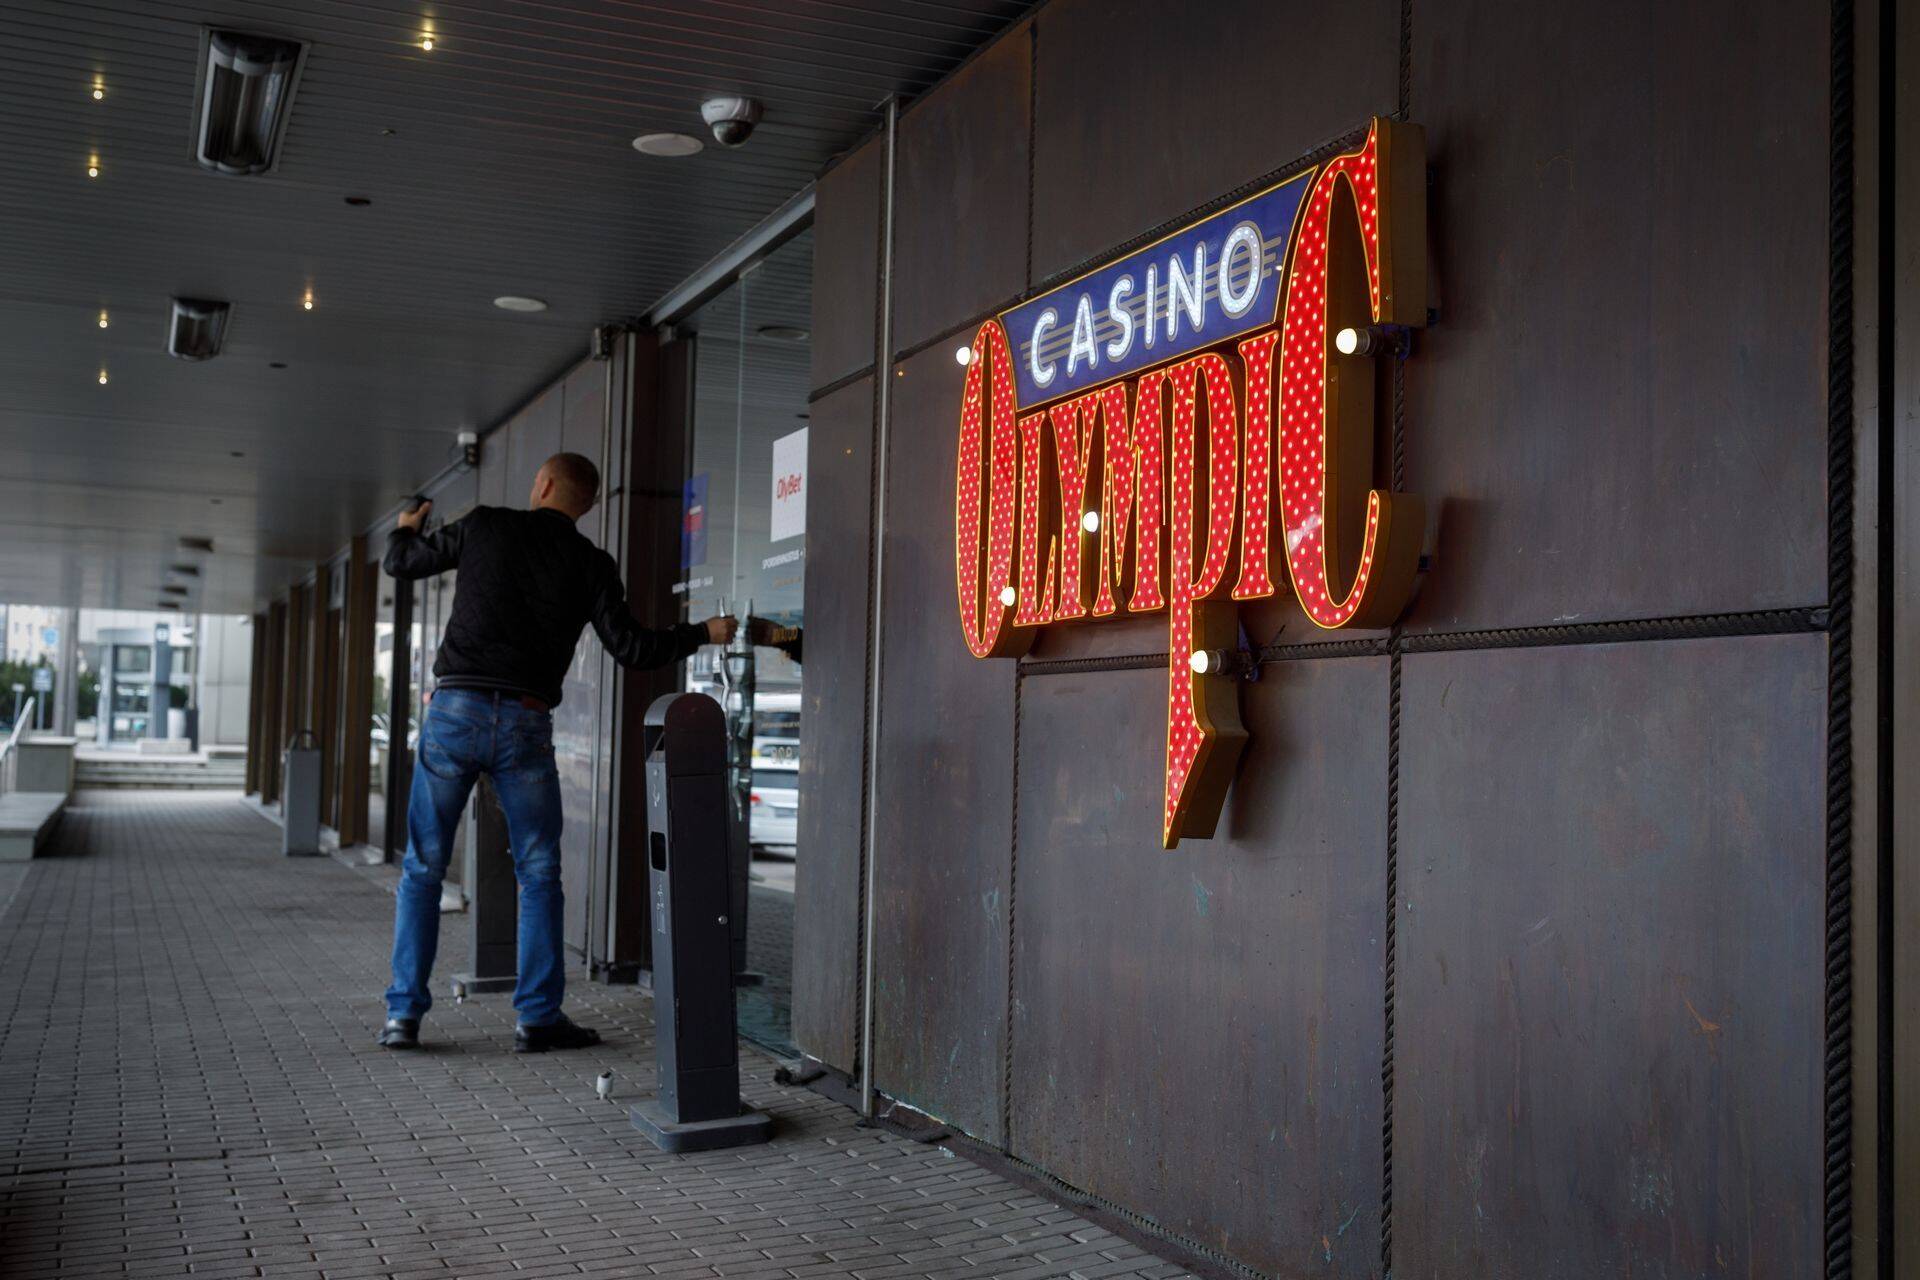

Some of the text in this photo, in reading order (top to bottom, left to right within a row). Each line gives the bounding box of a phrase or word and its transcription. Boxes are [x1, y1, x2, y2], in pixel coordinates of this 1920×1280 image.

[1030, 221, 1264, 388] CASINO
[777, 472, 802, 503] OlyBet
[956, 116, 1380, 849] OLYMPIC
